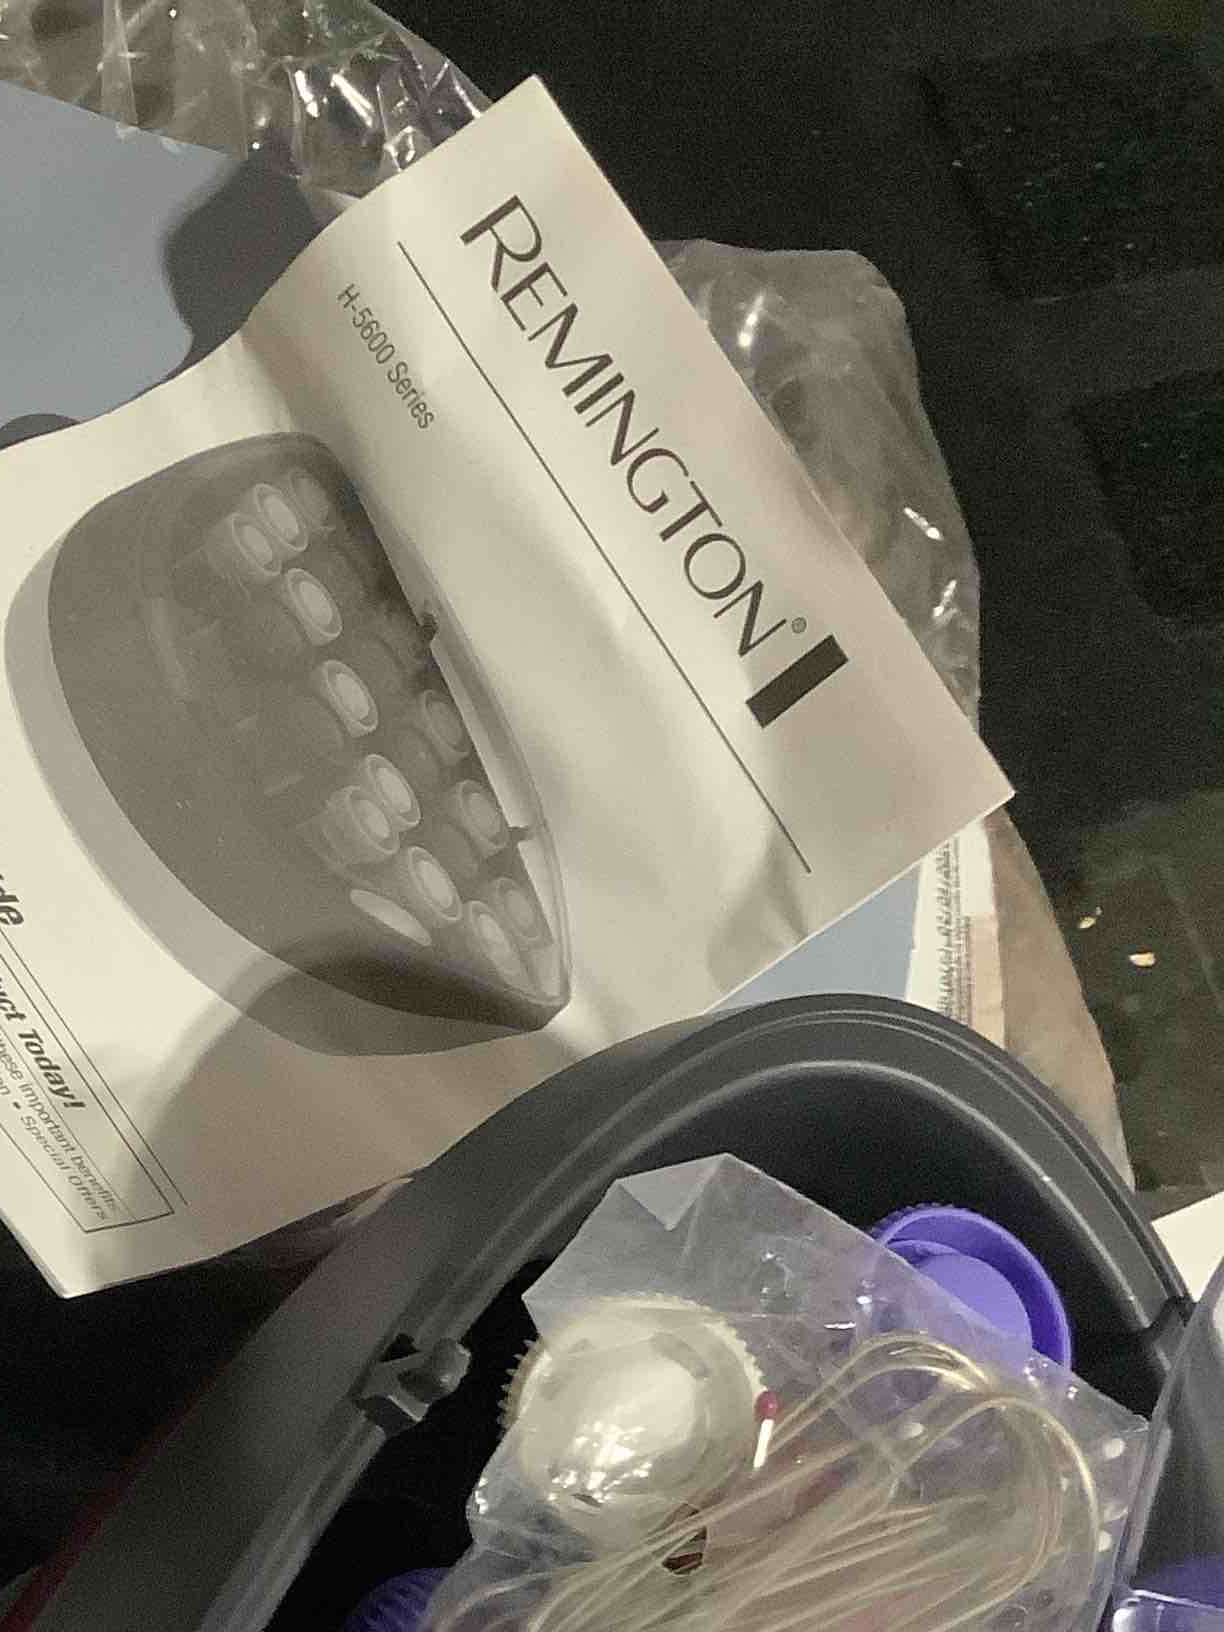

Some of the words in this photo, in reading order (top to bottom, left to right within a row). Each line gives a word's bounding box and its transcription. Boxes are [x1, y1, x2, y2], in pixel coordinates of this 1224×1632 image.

[337, 284, 395, 364] H-5600
[387, 361, 434, 429] Series
[18, 1028, 86, 1108] Today!
[18, 1082, 76, 1154] important
[20, 1116, 71, 1170] Special
